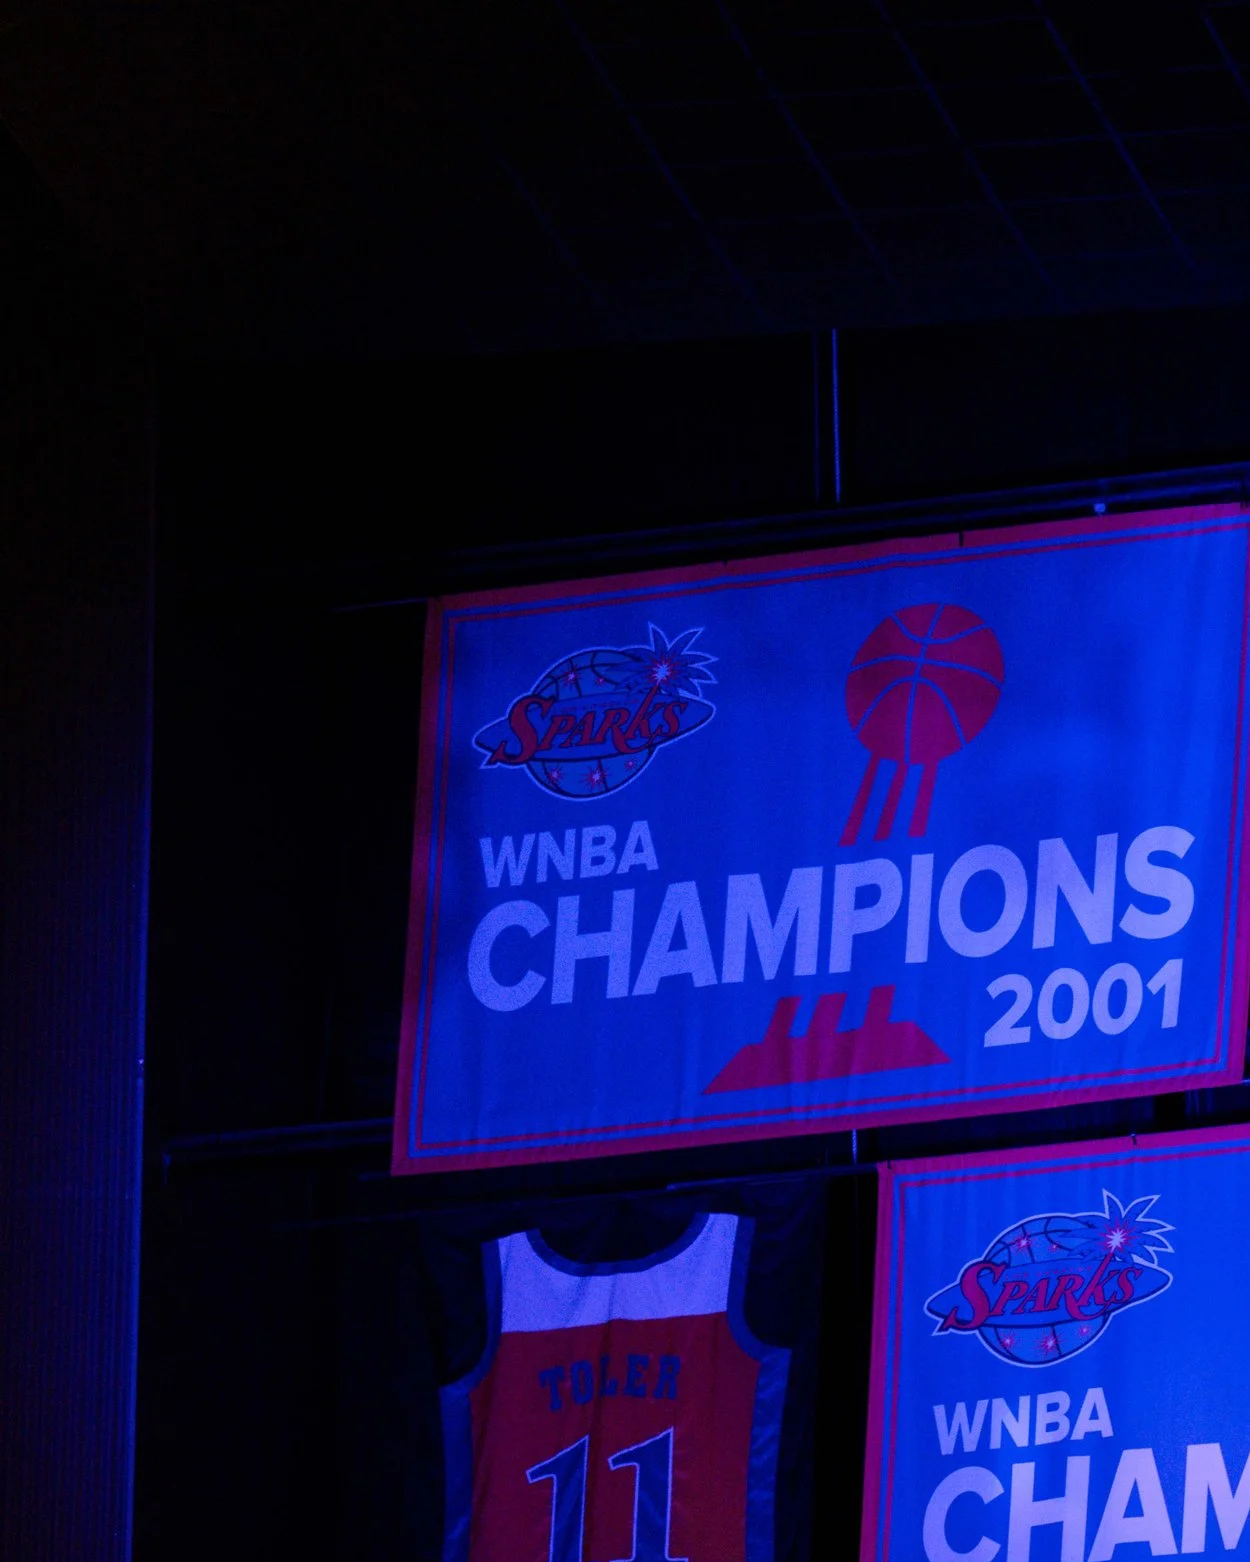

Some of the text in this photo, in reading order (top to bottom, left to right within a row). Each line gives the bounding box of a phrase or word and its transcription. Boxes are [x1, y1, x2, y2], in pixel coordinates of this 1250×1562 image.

[487, 684, 688, 765] SPARKS
[479, 820, 659, 888] WNBA
[467, 826, 1195, 1013] CHAMPIONS
[983, 958, 1184, 1049] 2001
[938, 1252, 1143, 1331] SPARKS
[537, 1352, 684, 1413] TOLER
[932, 1387, 1114, 1456] WNBA
